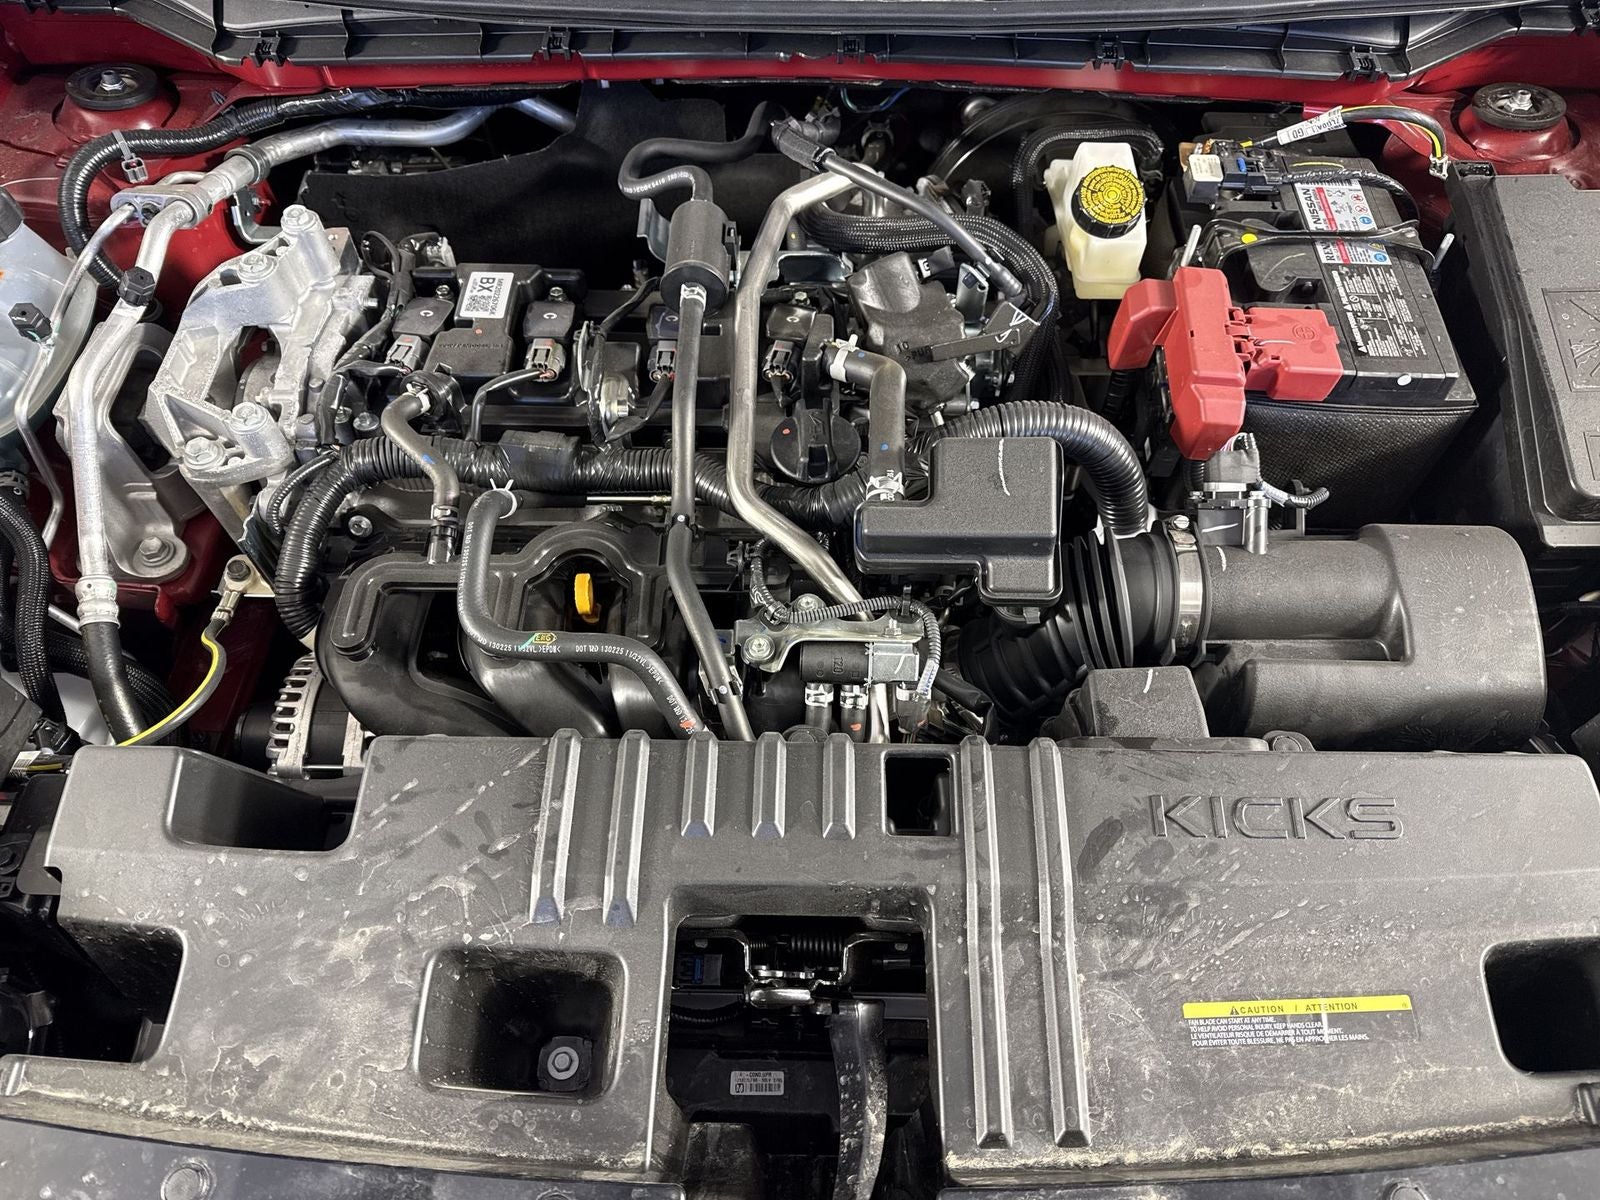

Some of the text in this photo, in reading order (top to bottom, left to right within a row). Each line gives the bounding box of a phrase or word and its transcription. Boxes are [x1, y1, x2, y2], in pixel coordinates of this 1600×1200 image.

[1302, 188, 1321, 225] NISSAN
[477, 277, 496, 292] BX
[489, 641, 512, 652] 130225
[575, 645, 587, 653] DOT
[601, 645, 624, 655] 130225
[666, 694, 678, 707] DOT
[1151, 795, 1404, 840] KICKS
[1239, 1005, 1284, 1015] CAUTION
[1305, 1002, 1358, 1012] ATTENTION
[1199, 1018, 1216, 1026] BLADE
[1198, 1031, 1235, 1039] VENTILATEUR
[1302, 1028, 1316, 1036] TOUT
